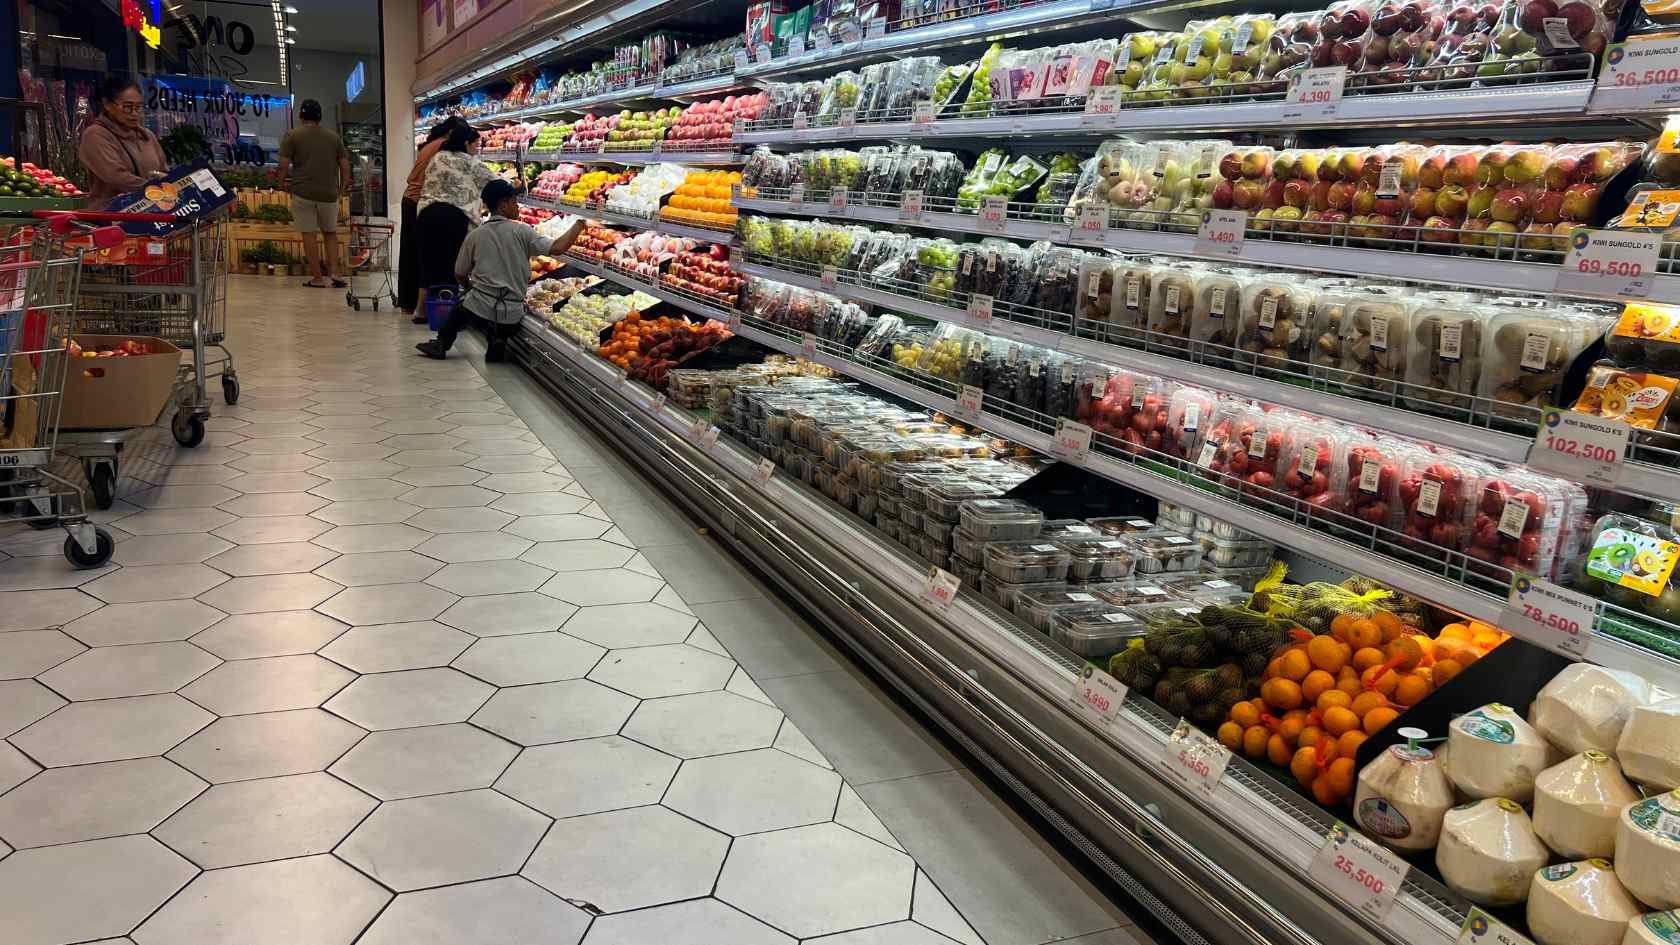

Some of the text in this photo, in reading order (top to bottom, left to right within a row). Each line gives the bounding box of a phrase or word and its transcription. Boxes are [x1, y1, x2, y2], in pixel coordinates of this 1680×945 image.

[1616, 68, 1679, 89] 36,500
[1592, 239, 1607, 247] KIWI
[1608, 240, 1642, 249] SUNGOLD
[1578, 258, 1642, 278] 69,500
[1579, 421, 1611, 434] SUNGOLD
[1546, 435, 1617, 464] 102,500
[1523, 603, 1579, 635] 78,500
[1333, 855, 1383, 894] 25,500
